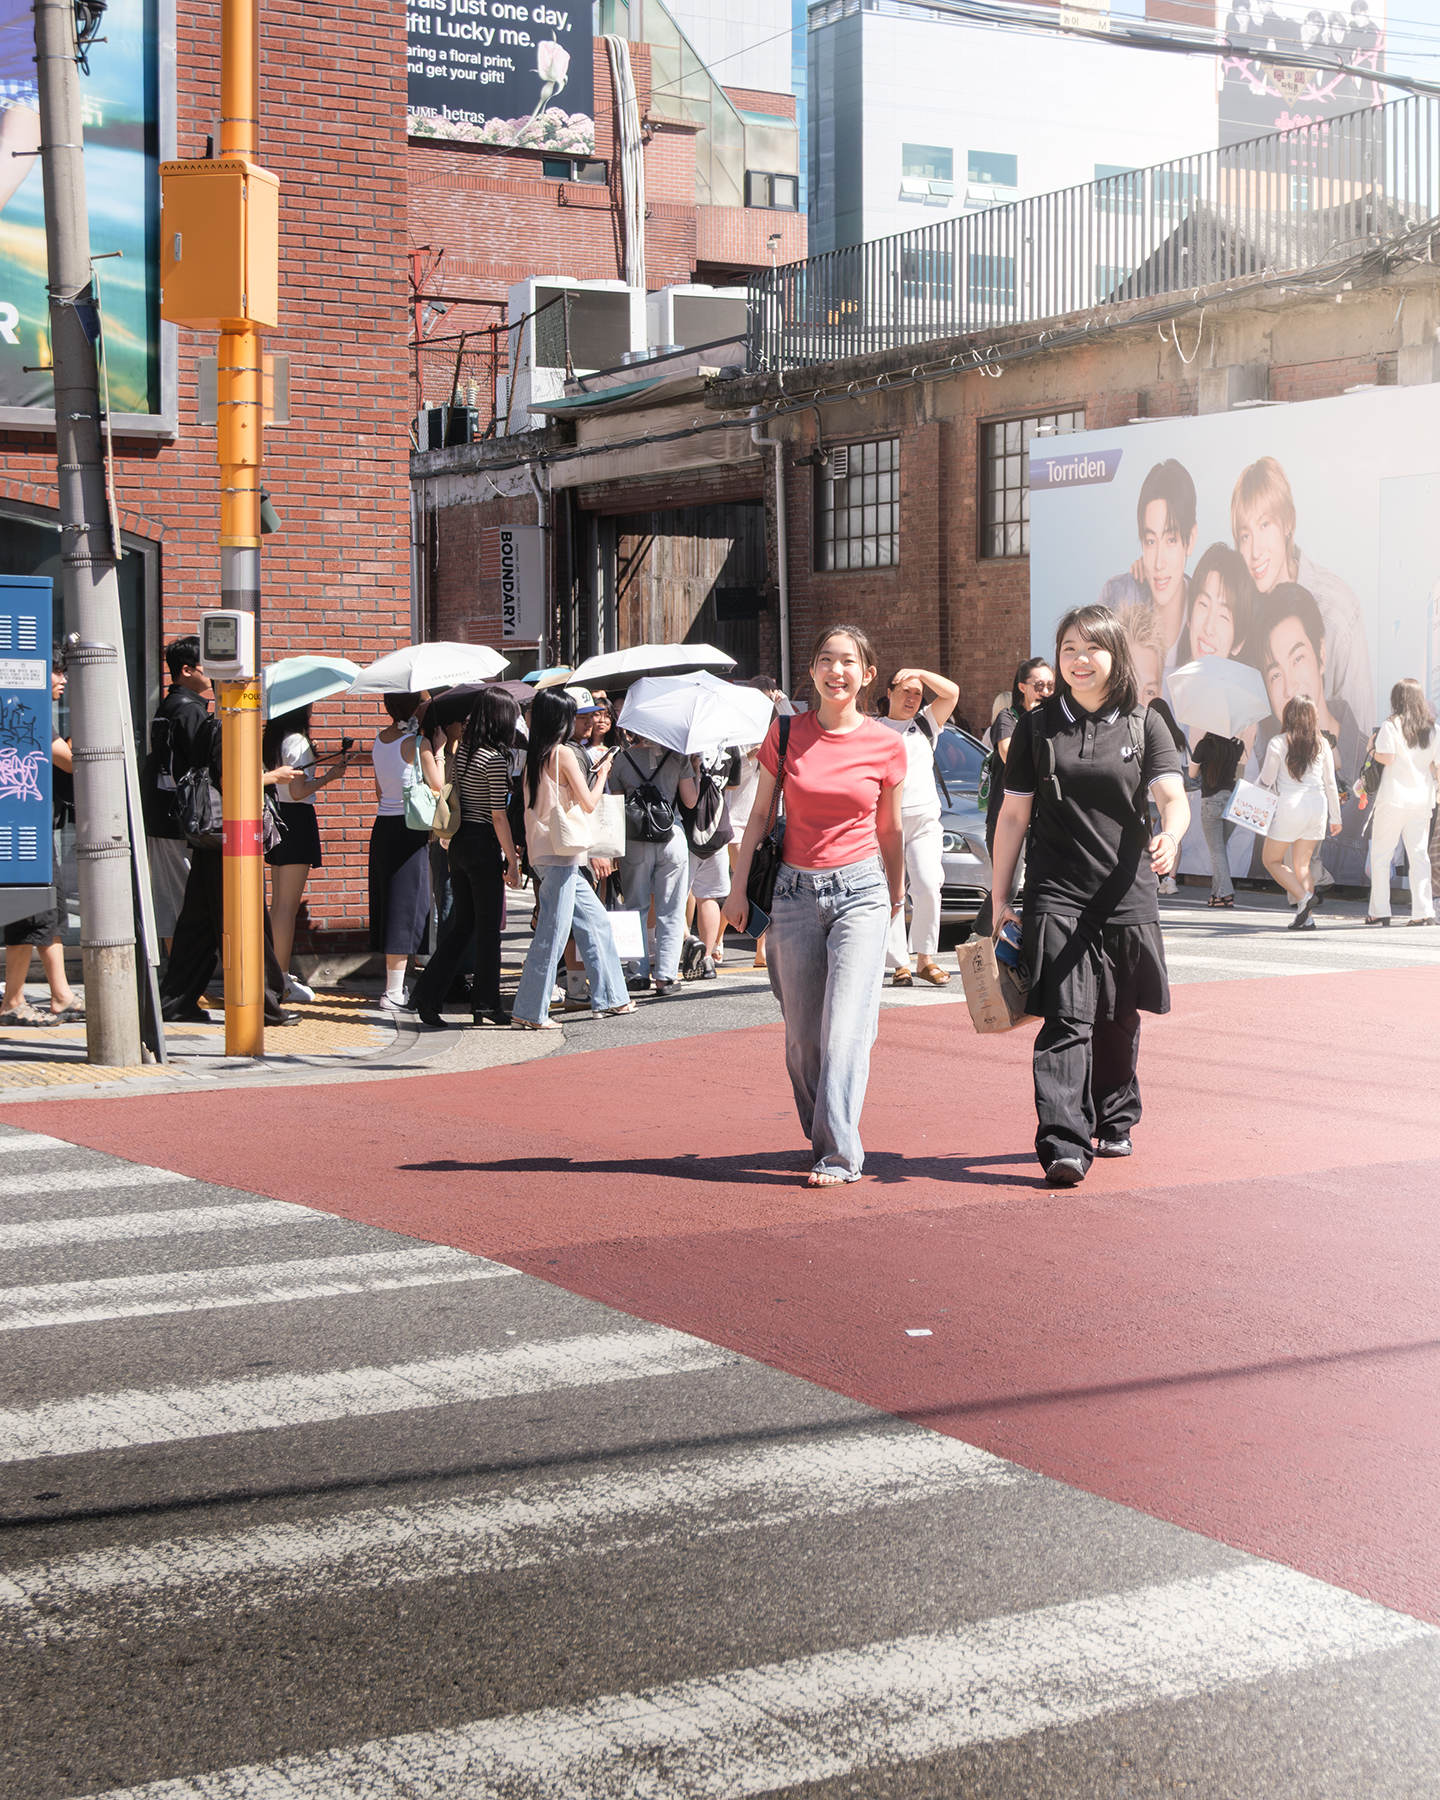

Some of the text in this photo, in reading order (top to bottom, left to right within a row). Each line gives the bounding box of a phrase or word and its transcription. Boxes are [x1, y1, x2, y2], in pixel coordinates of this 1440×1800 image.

[449, 0, 488, 16] just
[491, 2, 529, 21] one
[532, 4, 573, 32] day,
[436, 16, 496, 47] Lucky
[499, 28, 536, 48] me.
[439, 49, 448, 60] a
[449, 48, 482, 65] floral
[483, 54, 516, 72] print,
[426, 65, 448, 78] get
[449, 68, 479, 80] your
[480, 70, 505, 84] gift!
[442, 104, 486, 124] hetras
[1046, 456, 1106, 483] Torriden
[500, 531, 515, 628] BOUNDARY
